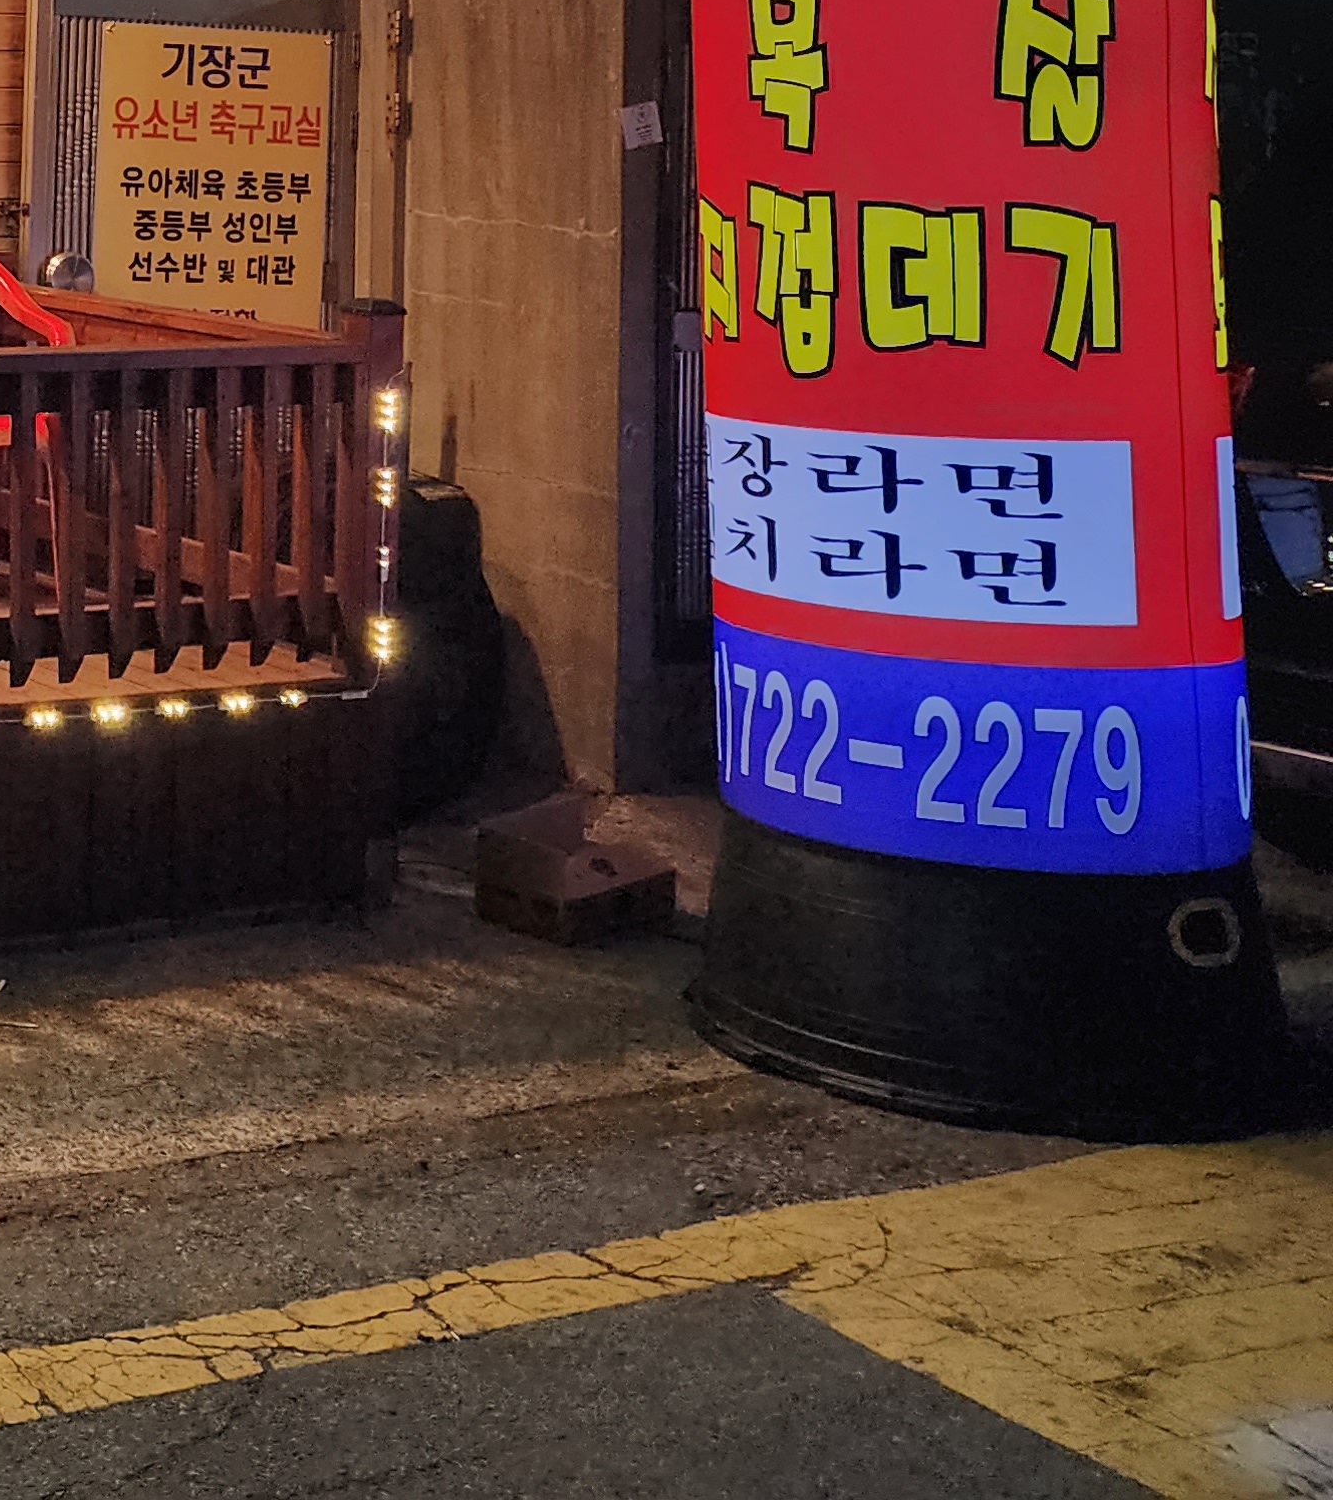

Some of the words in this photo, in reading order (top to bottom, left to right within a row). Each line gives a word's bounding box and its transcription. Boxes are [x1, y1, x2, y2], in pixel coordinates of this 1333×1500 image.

[161, 43, 271, 90] 기장군
[112, 97, 198, 142] 유소년
[209, 100, 322, 148] 축구교실
[120, 167, 226, 200] 유아체육
[235, 171, 312, 203] 초등부
[133, 209, 212, 242] 중등부
[222, 212, 298, 244] 성인부
[128, 252, 207, 283] 선수반
[218, 259, 235, 283] 및
[247, 255, 296, 285] 대관
[707, 423, 1062, 520] 장라면
[711, 502, 1066, 607] 치라면
